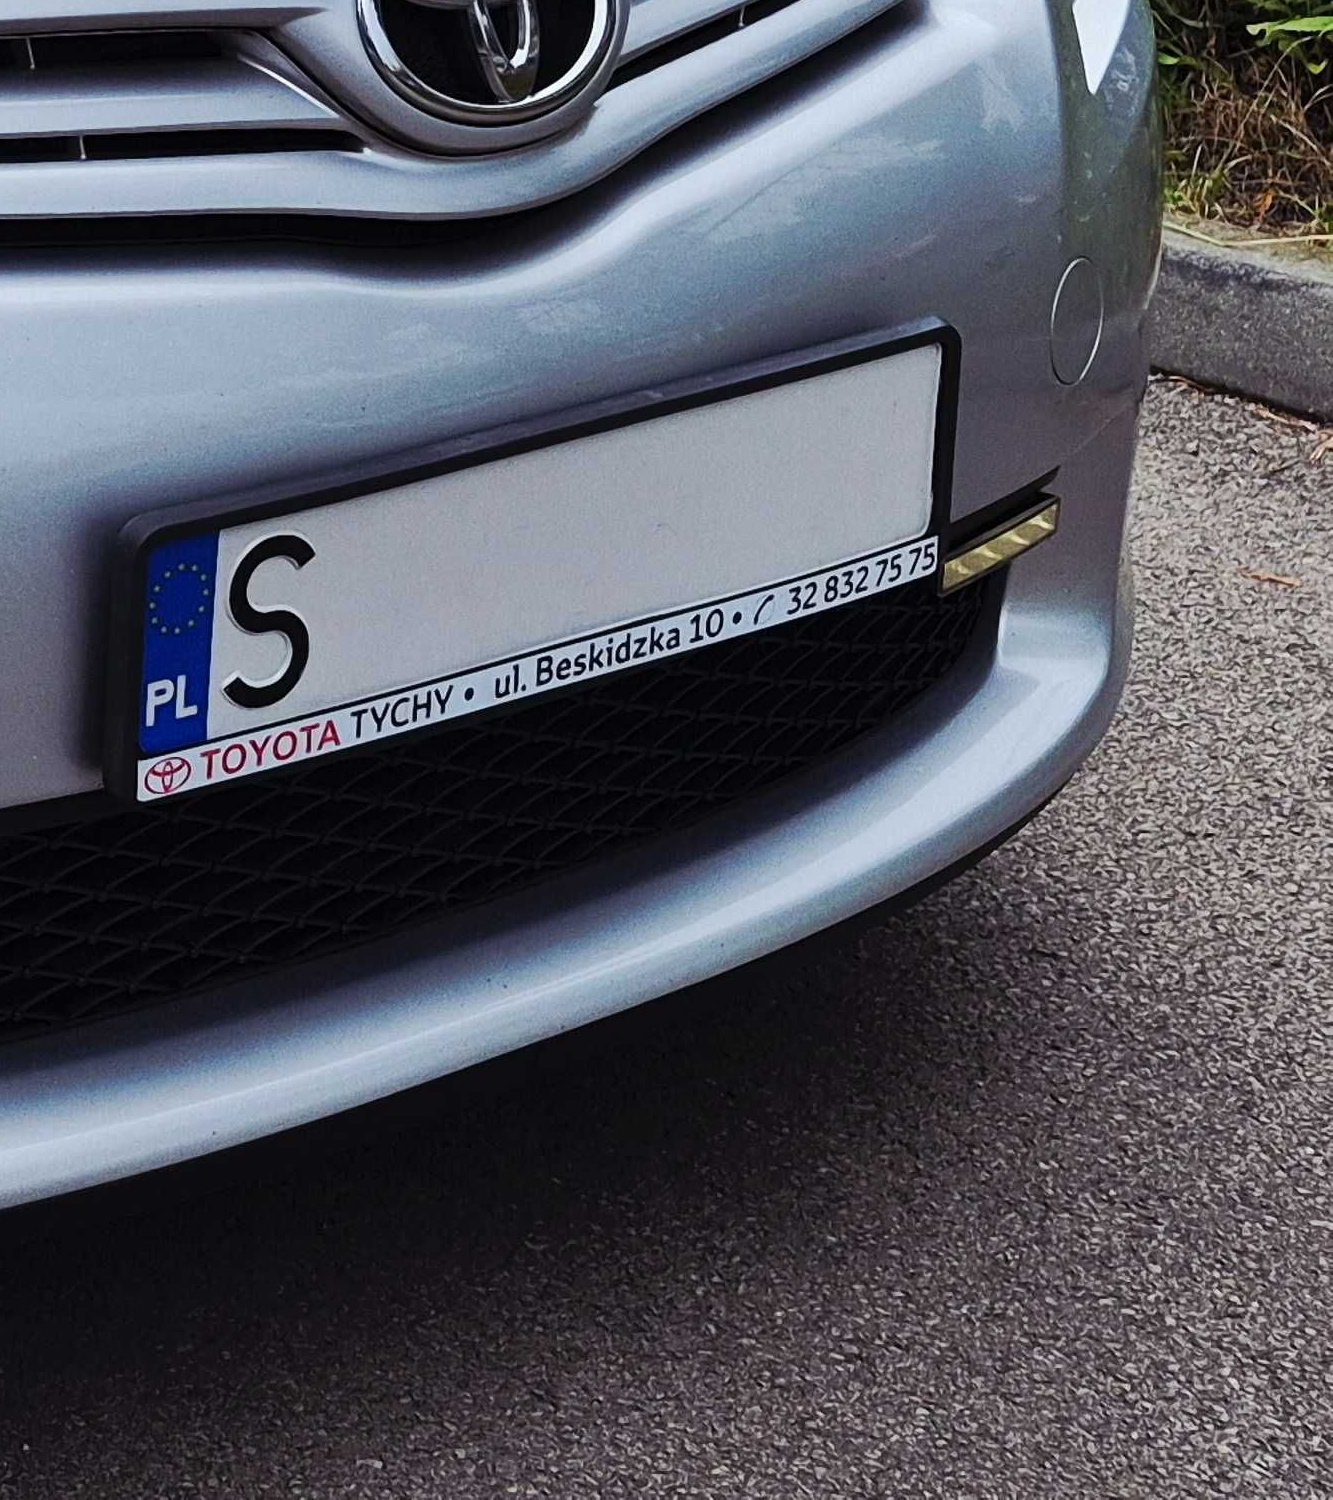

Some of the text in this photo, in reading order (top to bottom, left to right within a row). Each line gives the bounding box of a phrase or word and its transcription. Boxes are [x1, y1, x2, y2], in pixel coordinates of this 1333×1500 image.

[145, 674, 198, 727] PL
[200, 542, 936, 780] TOYOTA TYCHY ul. Beskidzka 10 32 832 75 75
[223, 534, 316, 709] S
